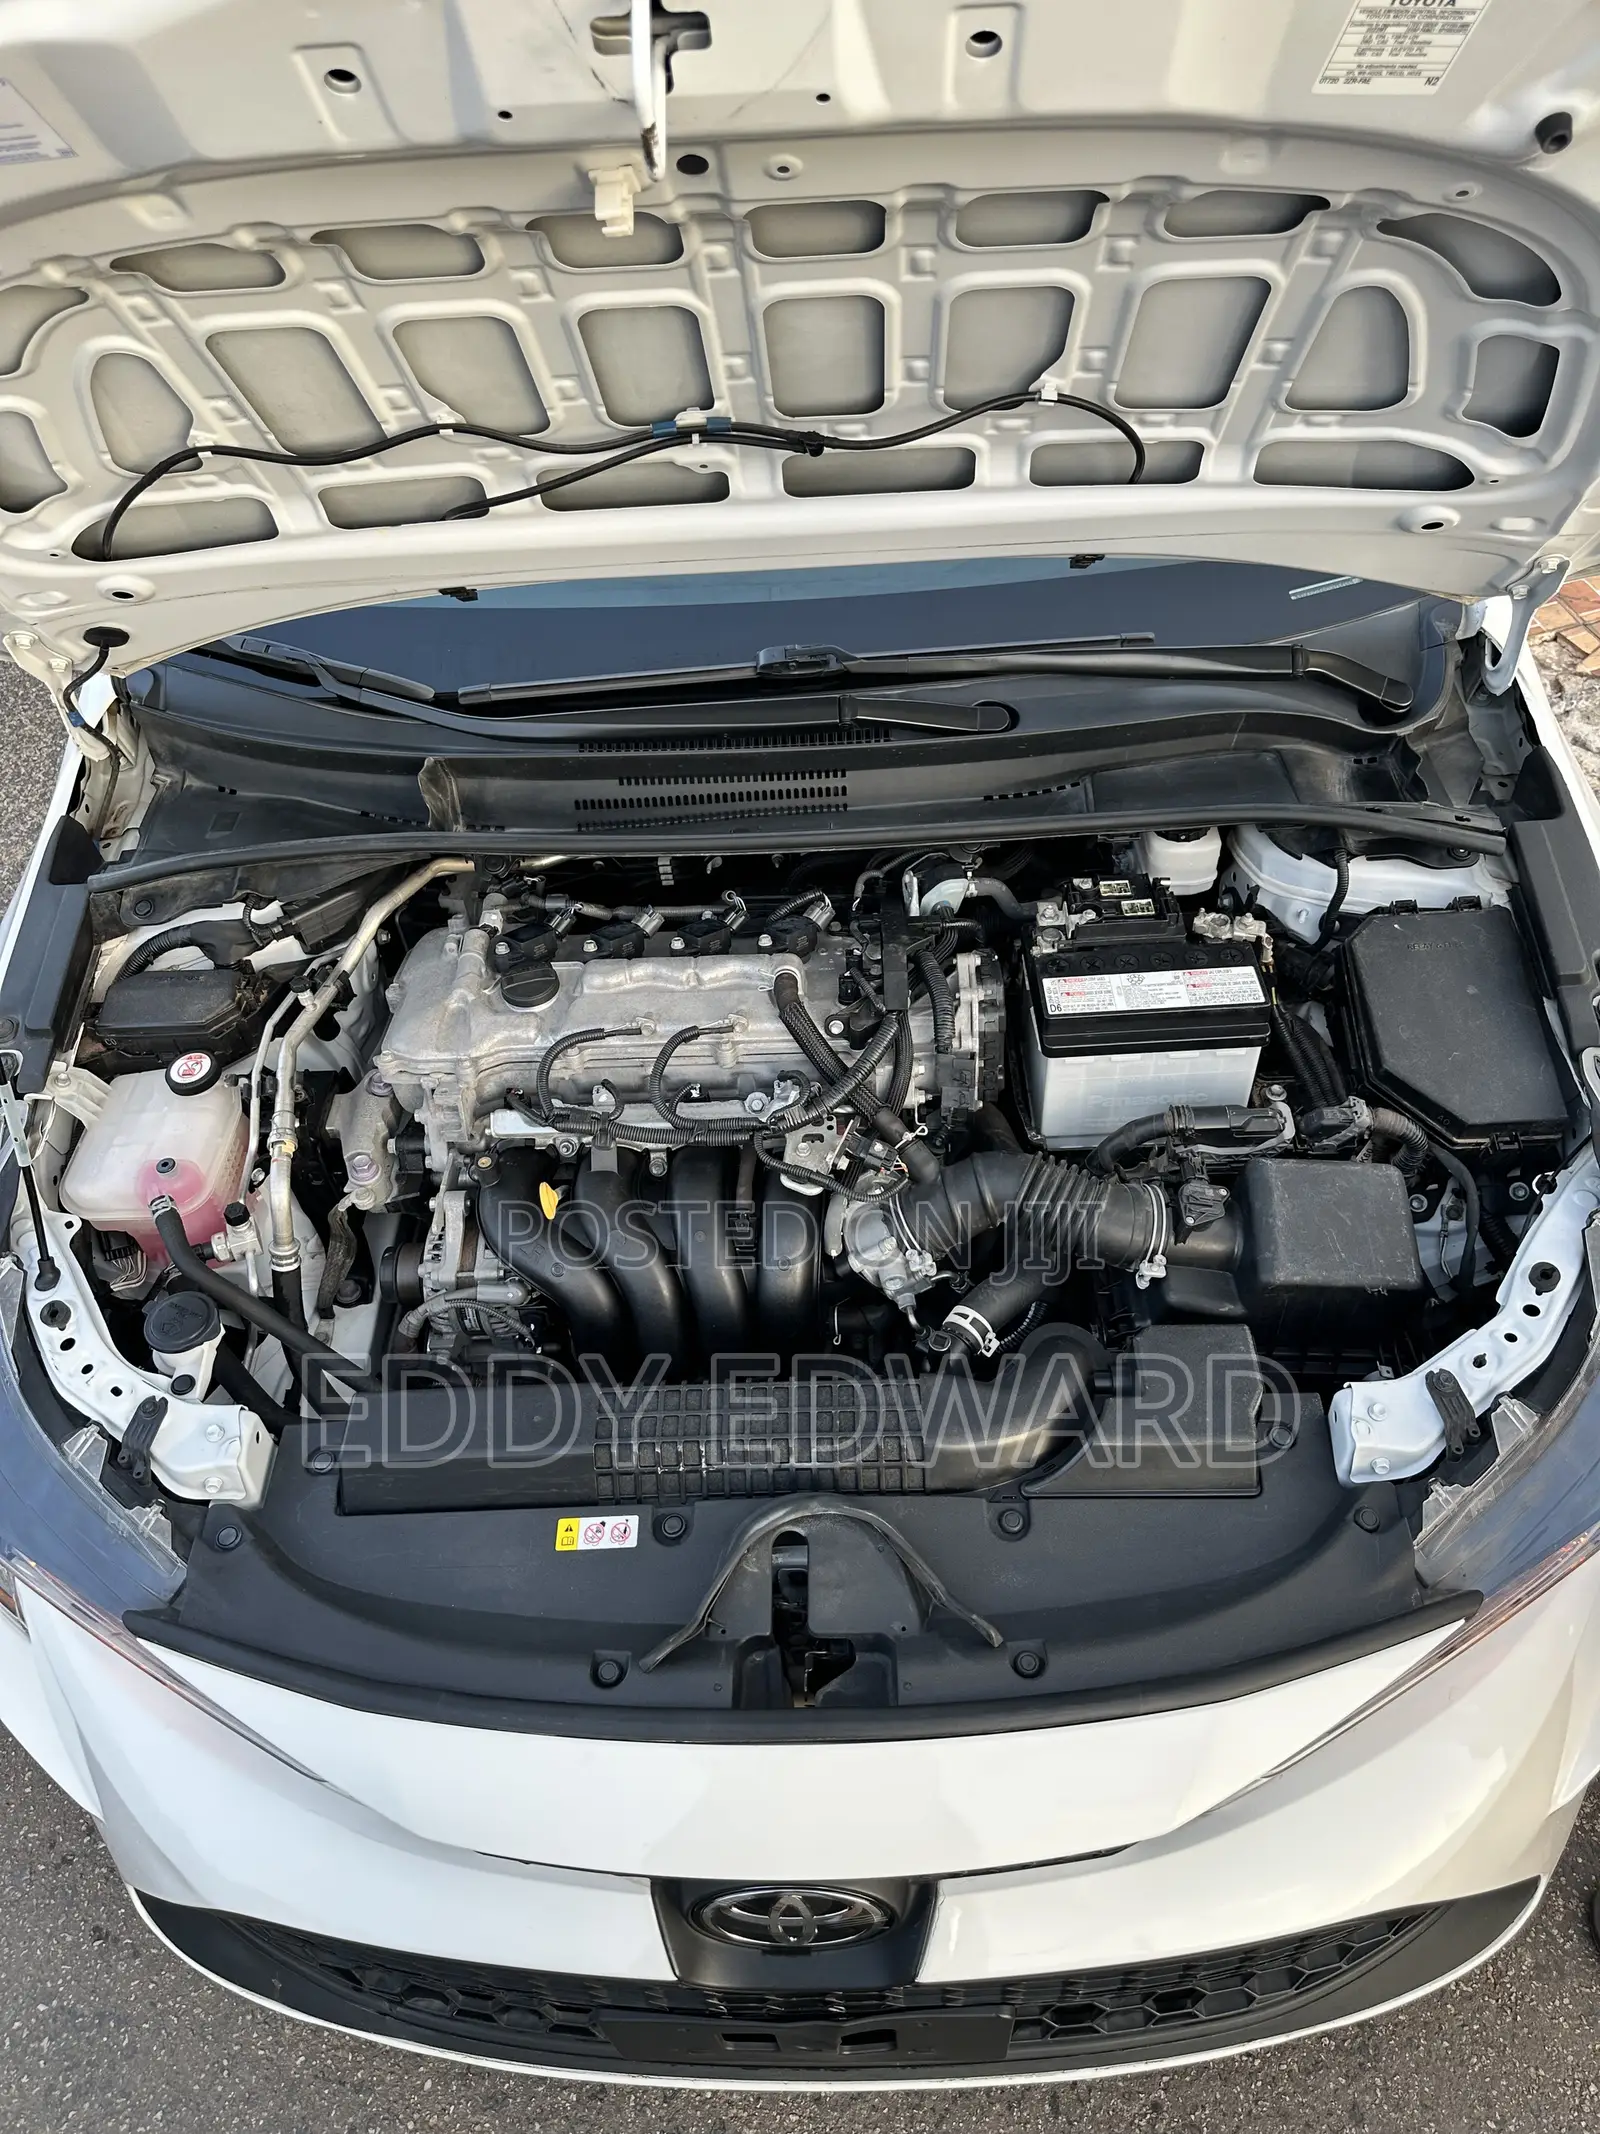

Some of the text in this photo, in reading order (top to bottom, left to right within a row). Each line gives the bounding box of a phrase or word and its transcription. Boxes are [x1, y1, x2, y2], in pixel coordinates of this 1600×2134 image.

[1424, 76, 1440, 86] N2
[1049, 1004, 1062, 1013] D6
[1088, 1090, 1208, 1108] Panasonic
